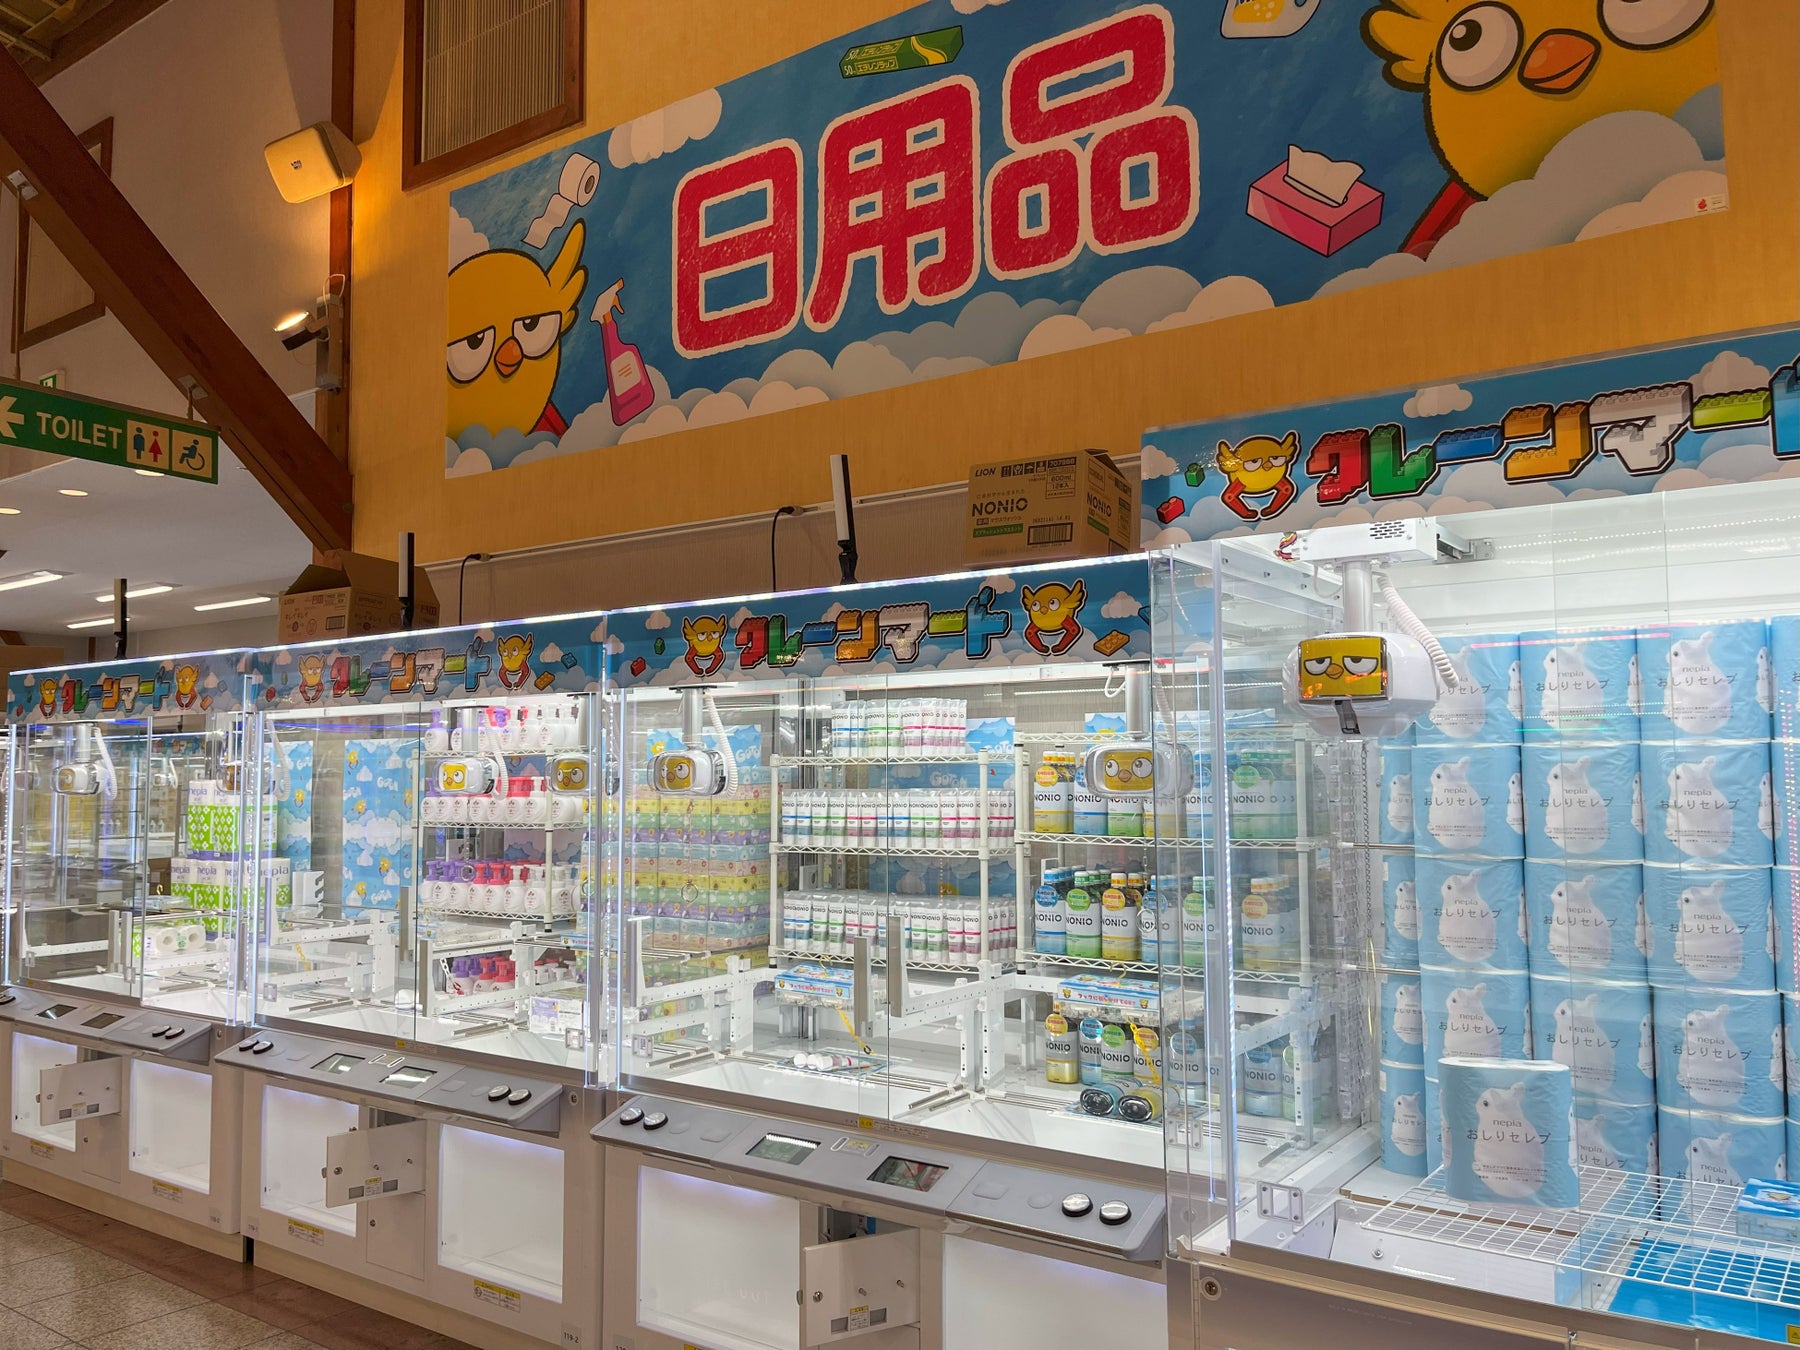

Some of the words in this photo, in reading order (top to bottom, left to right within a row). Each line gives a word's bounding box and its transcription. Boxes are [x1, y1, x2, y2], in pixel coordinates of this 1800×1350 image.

[674, 6, 1197, 356] 日用品
[37, 411, 122, 449] TOILET
[975, 467, 996, 477] LION
[972, 498, 1028, 517] NONIO
[1087, 492, 1112, 518] NONIO
[734, 586, 1012, 667] クレーンマート
[329, 636, 492, 699] クレーンマート
[1682, 665, 1710, 673] nepia
[61, 665, 171, 713] クレーンマート
[1440, 684, 1491, 696] しりセレブ
[1066, 917, 1093, 925] NONIO
[1102, 919, 1129, 927] NONIO
[1184, 923, 1215, 932] NONO
[1242, 926, 1274, 936] NONIO
[1697, 1037, 1725, 1045] nepia
[1080, 1046, 1101, 1055] NONI
[1101, 1052, 1131, 1063] NONIO
[1245, 1070, 1276, 1082] NONIO
[1493, 1118, 1523, 1128] nepia
[1579, 1154, 1629, 1169] りセレブ
[563, 1332, 579, 1344] 119-2
